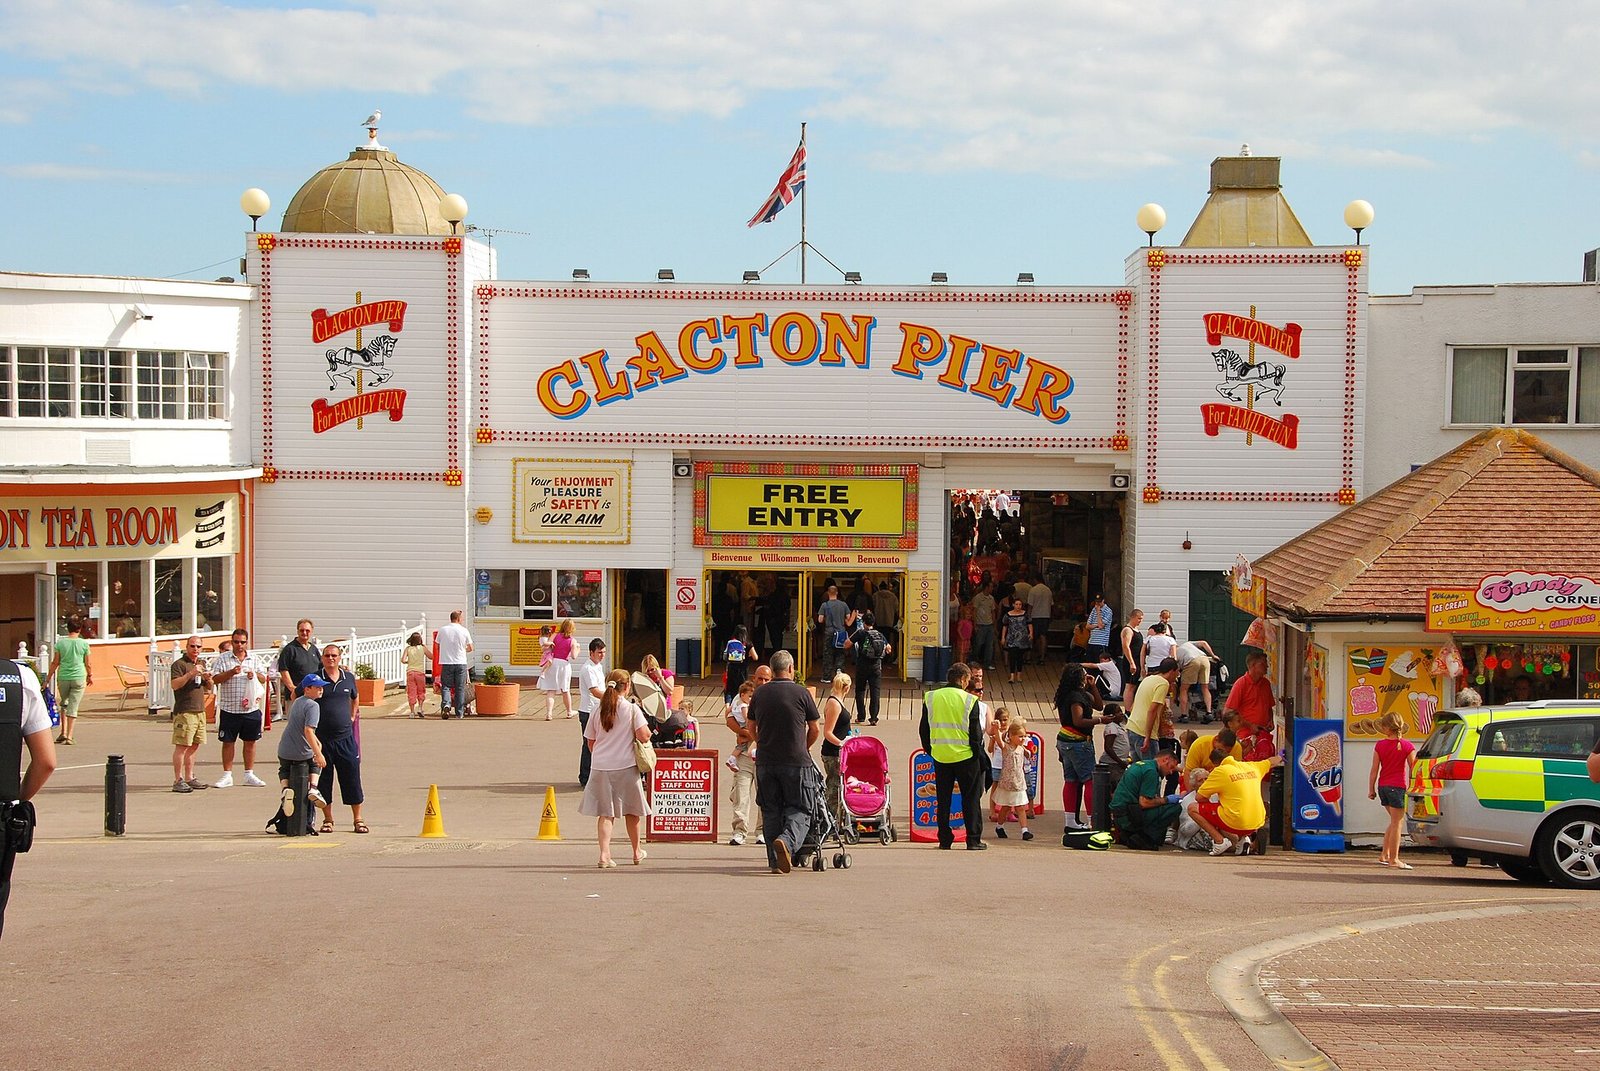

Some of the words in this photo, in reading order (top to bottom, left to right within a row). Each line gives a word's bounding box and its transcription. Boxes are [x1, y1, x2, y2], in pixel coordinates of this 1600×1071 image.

[315, 304, 373, 341] CLACTON
[375, 301, 403, 324] PIER
[1208, 314, 1268, 345] CLACTON
[1269, 330, 1294, 357] PIER
[537, 312, 878, 419] CLACTON
[892, 321, 1076, 425] PIER
[316, 410, 333, 432] For
[334, 392, 377, 425] FAMILY
[378, 391, 404, 411] FUN
[1208, 404, 1225, 425] For
[1227, 406, 1269, 435] FAMILY
[1269, 425, 1293, 447] FUN
[530, 476, 552, 487] Your
[554, 477, 614, 487] ENJOYMENT
[543, 487, 602, 497] PLEASURE
[763, 484, 849, 504] FREE
[529, 497, 548, 512] and
[550, 499, 600, 510] SAFETY
[601, 499, 611, 509] is
[541, 513, 573, 525] OUR
[574, 513, 606, 525] AIM
[748, 507, 863, 527] ENTRY
[41, 506, 98, 551] TEA
[105, 506, 179, 546] ROOM
[711, 552, 753, 562] Bienvenue
[760, 553, 810, 563] Willkommen
[817, 554, 850, 563] Welkom
[857, 554, 900, 564] Benvenuto
[1432, 592, 1459, 600] Whippy
[1482, 577, 1583, 603] Candy
[1545, 595, 1600, 604] CORNE
[1432, 603, 1443, 614] ICE
[1444, 599, 1468, 612] CREAM
[1448, 612, 1479, 624] CLACTON
[1471, 617, 1490, 628] ROCK
[1503, 617, 1537, 629] POPCORN
[1549, 617, 1573, 629] CANDY
[1573, 614, 1596, 625] FLOSS
[1378, 683, 1411, 694] Whippy
[673, 760, 692, 770] NO
[916, 762, 932, 771] HOT
[655, 770, 710, 779] PARKING
[1308, 766, 1342, 789] fab
[920, 811, 930, 824] 4
